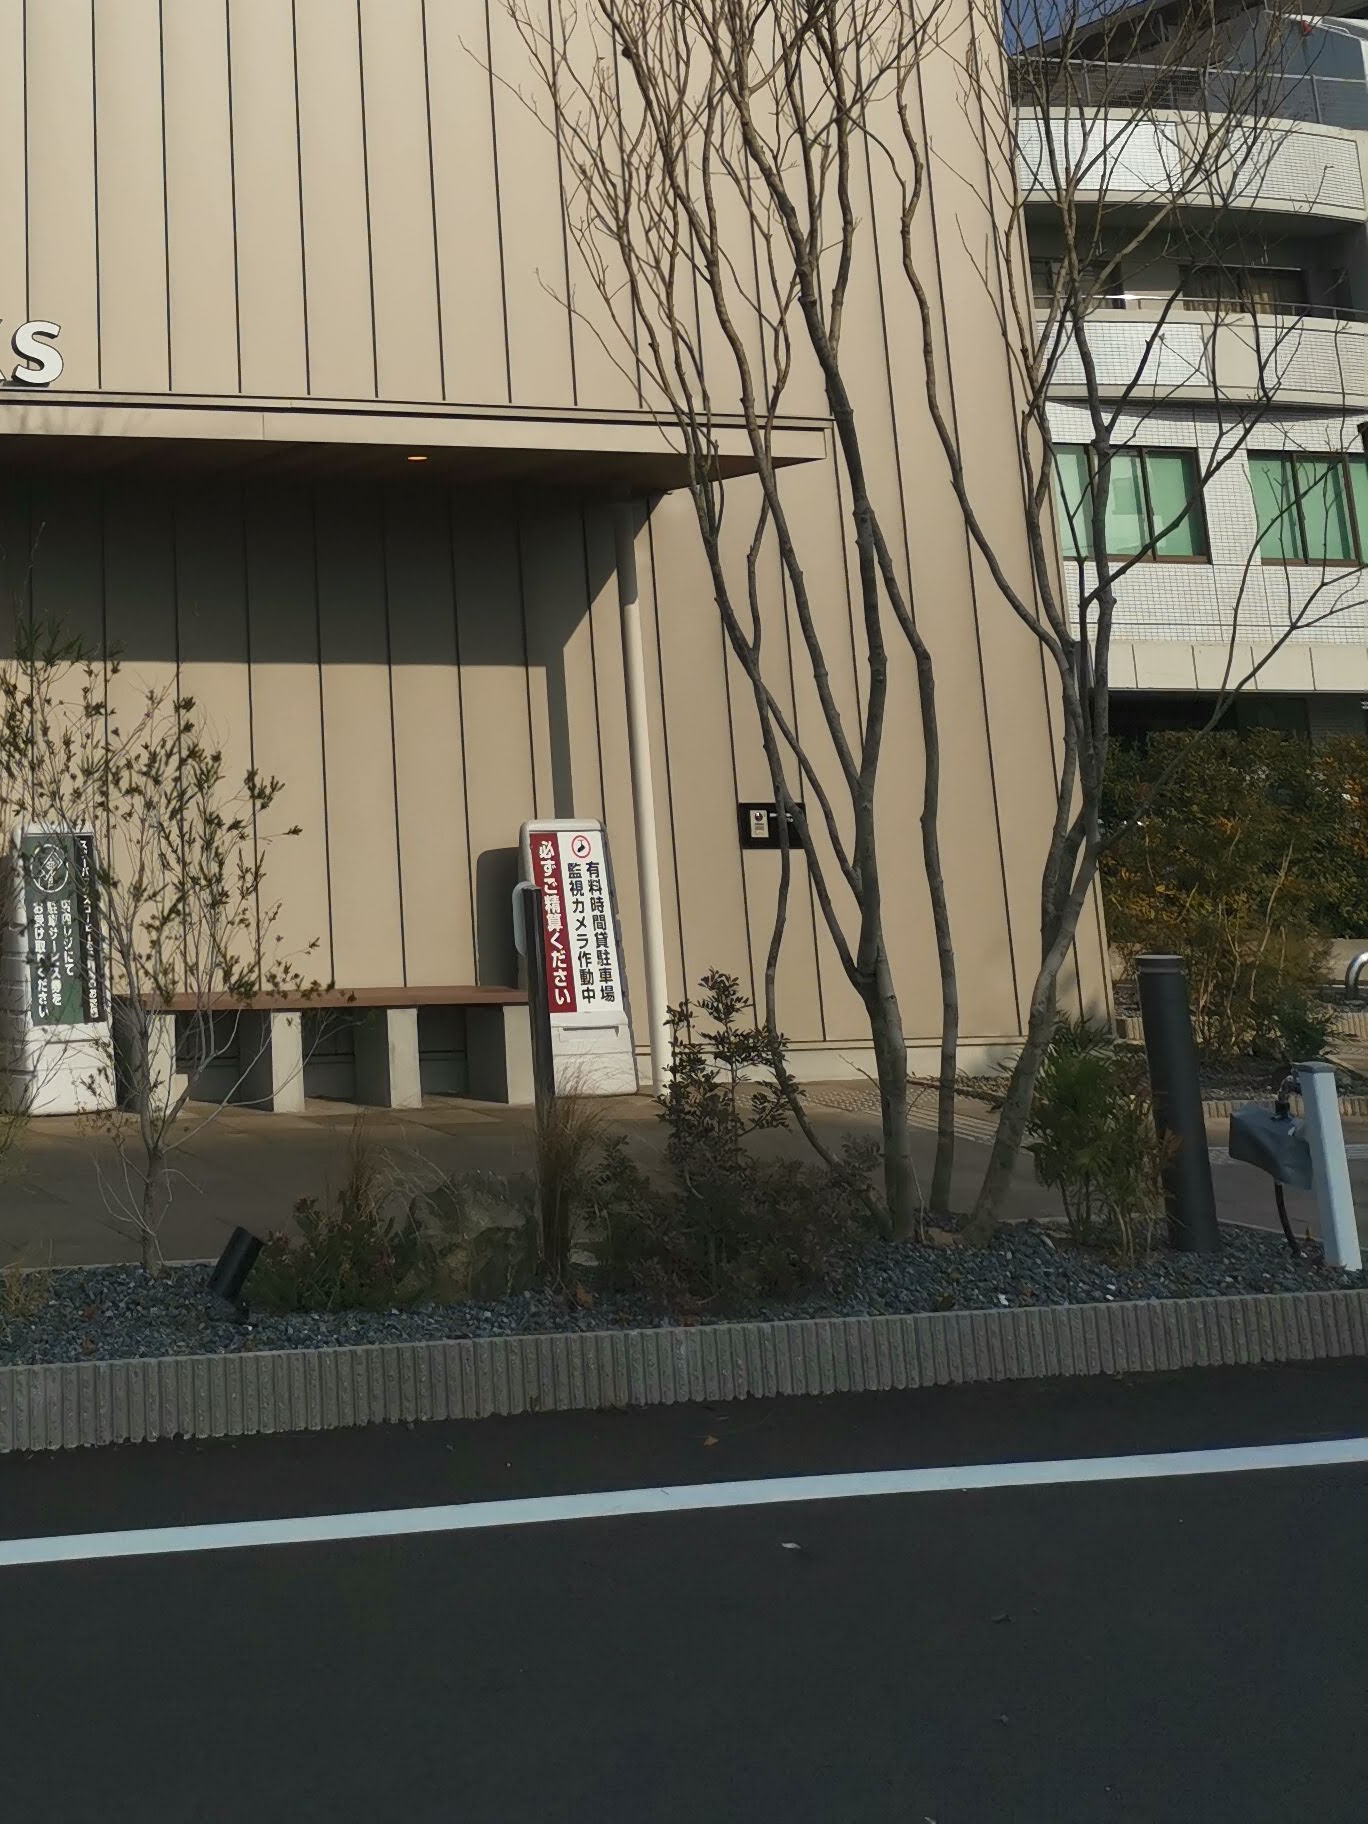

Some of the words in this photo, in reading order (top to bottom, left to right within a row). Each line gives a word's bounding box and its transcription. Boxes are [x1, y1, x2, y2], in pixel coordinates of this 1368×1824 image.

[538, 840, 571, 1005] 必ずご精算ください
[567, 862, 597, 1005] 監視カメラ作動中
[586, 860, 616, 1003] 有料時間貸駐車場
